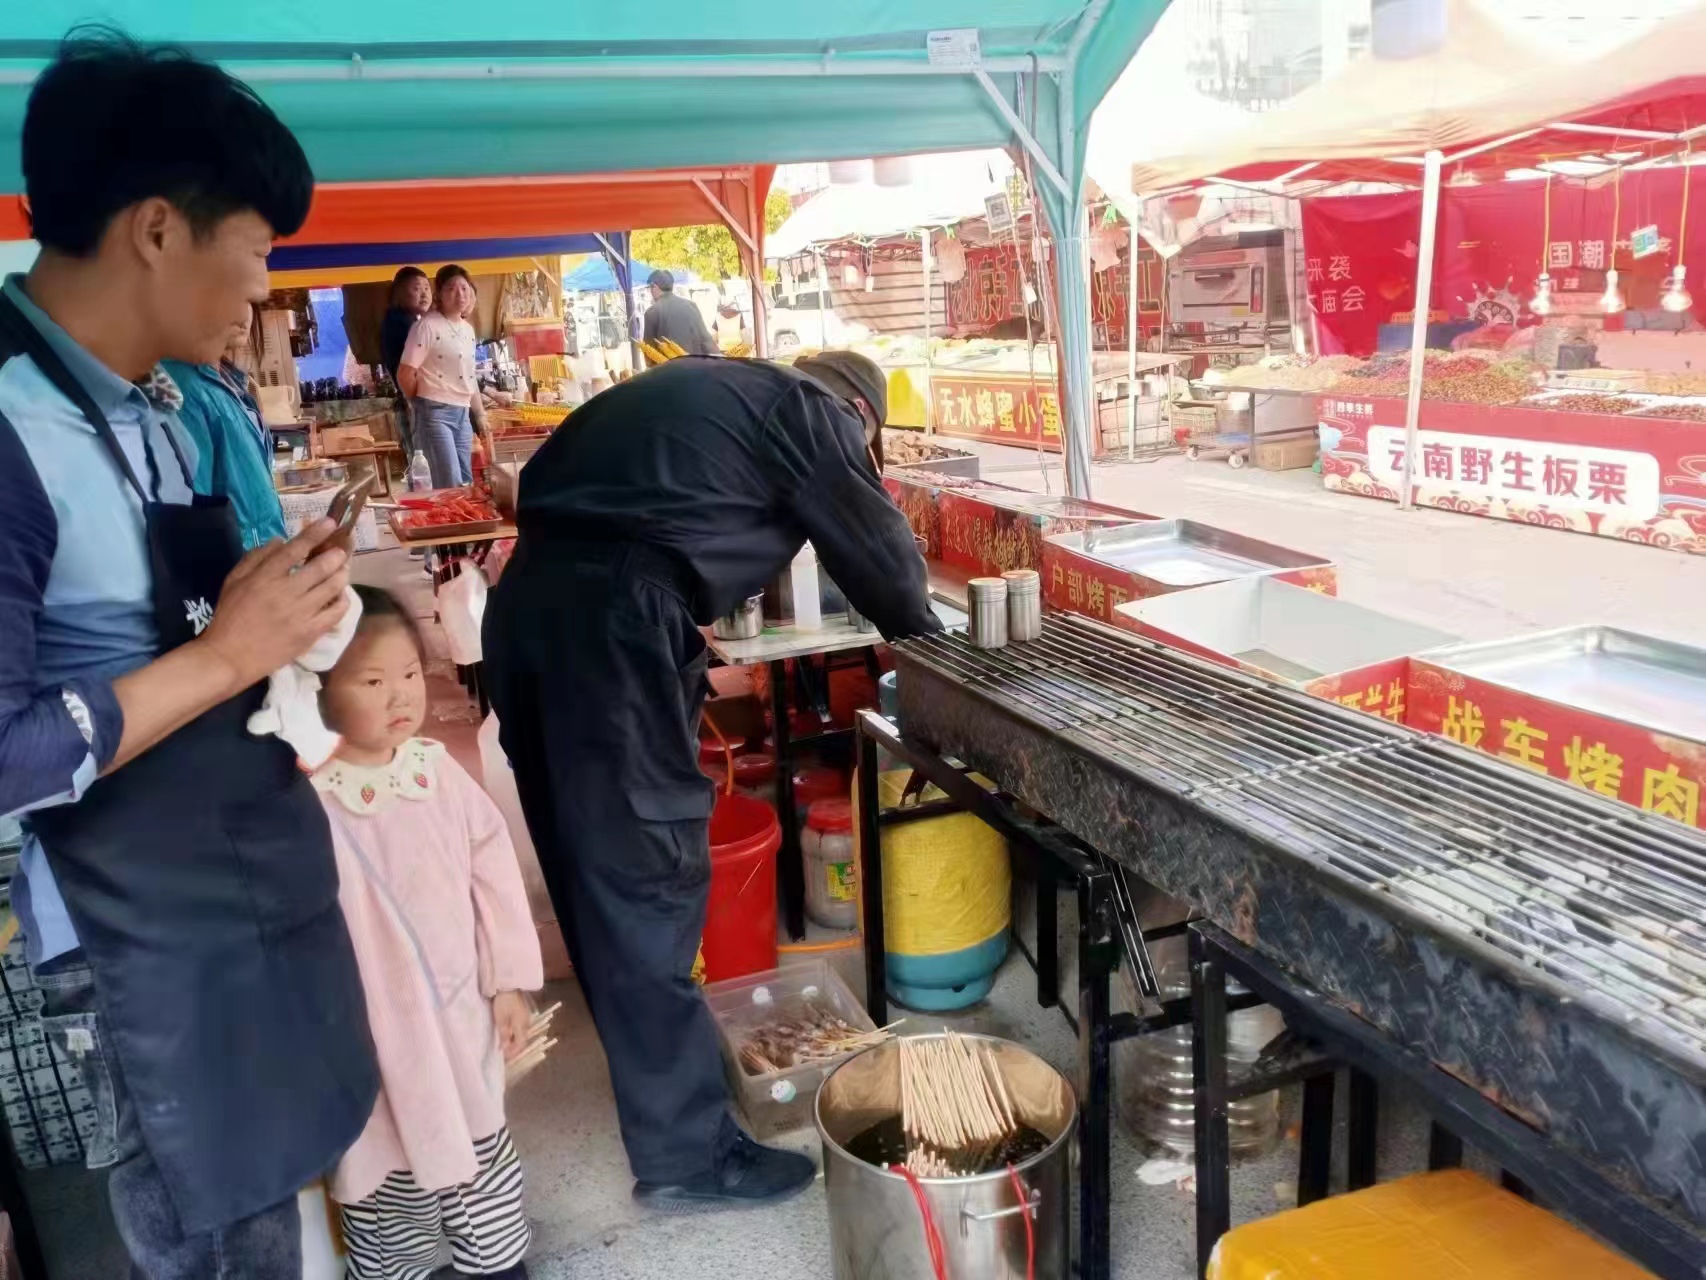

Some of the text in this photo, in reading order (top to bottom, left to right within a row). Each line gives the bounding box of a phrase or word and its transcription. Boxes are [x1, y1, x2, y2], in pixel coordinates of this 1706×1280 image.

[1388, 437, 1629, 506] 云南野生板栗
[1441, 695, 1700, 827] 战车烤肉
